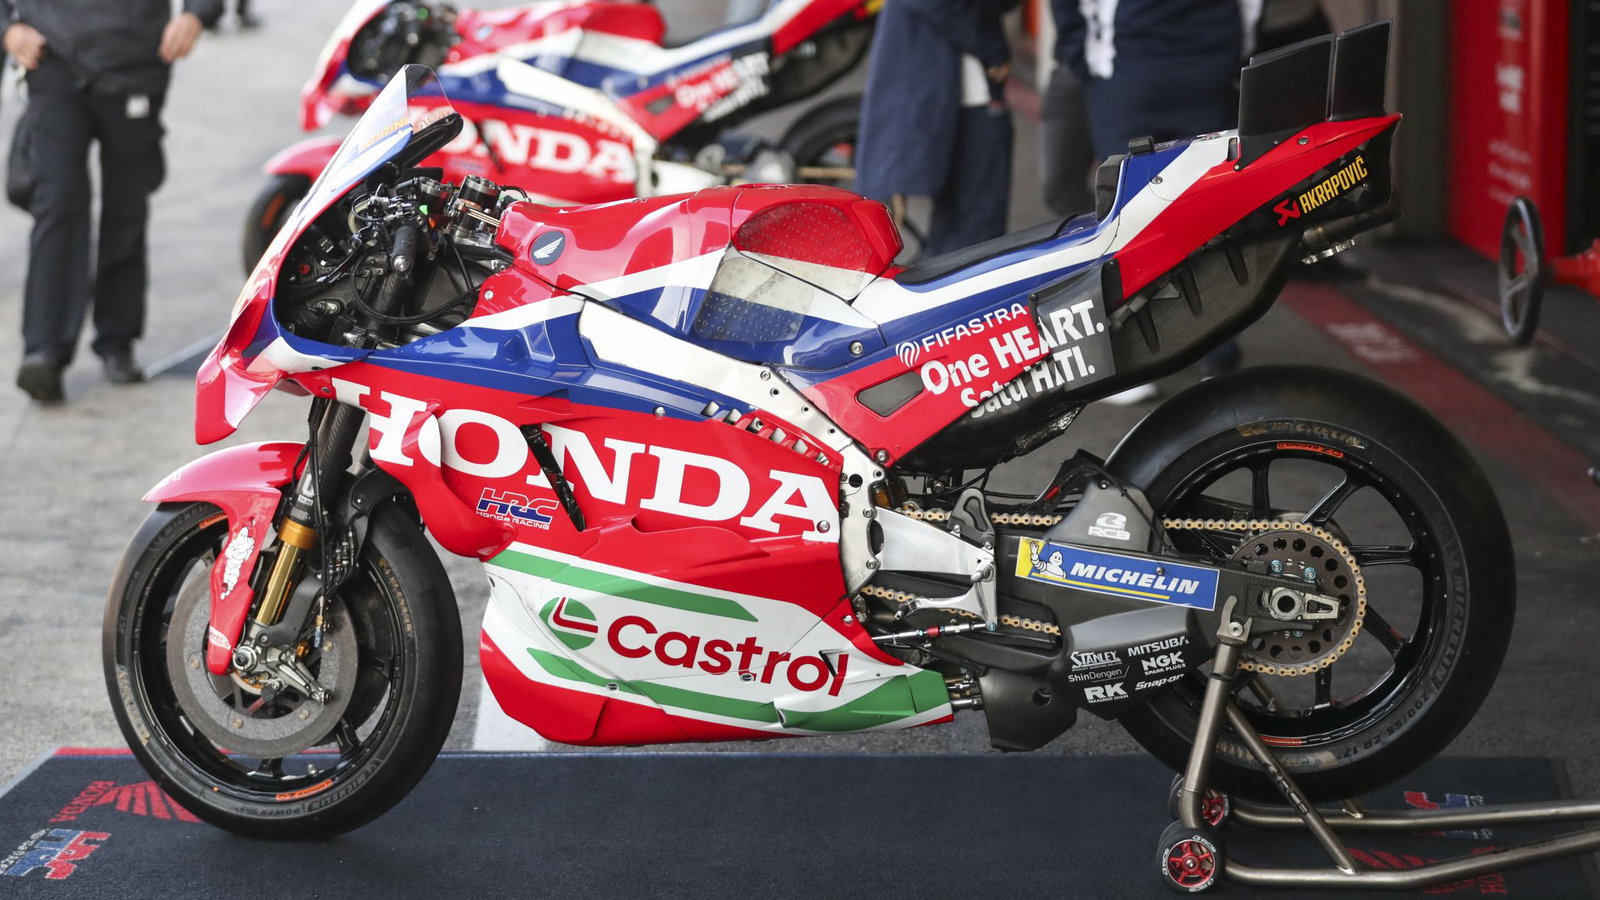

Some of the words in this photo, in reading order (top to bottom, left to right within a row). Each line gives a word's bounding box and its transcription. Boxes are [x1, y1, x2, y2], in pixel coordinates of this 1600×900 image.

[921, 302, 1027, 352] FIFASTRA
[920, 352, 990, 395] One
[989, 299, 1105, 369] HEART.
[960, 377, 1029, 419] Satu
[332, 377, 840, 543] HONDA
[476, 487, 560, 524] HRC
[476, 510, 511, 522] Honda
[511, 517, 551, 531] RACING
[1088, 525, 1131, 541] RCB
[1069, 562, 1200, 595] MICHELIN
[1435, 575, 1465, 684] MICHELIN
[607, 615, 849, 697] Castrol
[1128, 635, 1190, 657] MITSUBA
[1070, 650, 1122, 671] STANLEY
[1141, 651, 1185, 671] NGK
[1144, 668, 1164, 676] SPARK
[1165, 663, 1187, 672] PLUGS
[1068, 669, 1122, 683] ShinDengen
[1135, 673, 1185, 691] Snap-on
[1084, 682, 1128, 701] RK
[312, 773, 366, 810] MICHELIN
